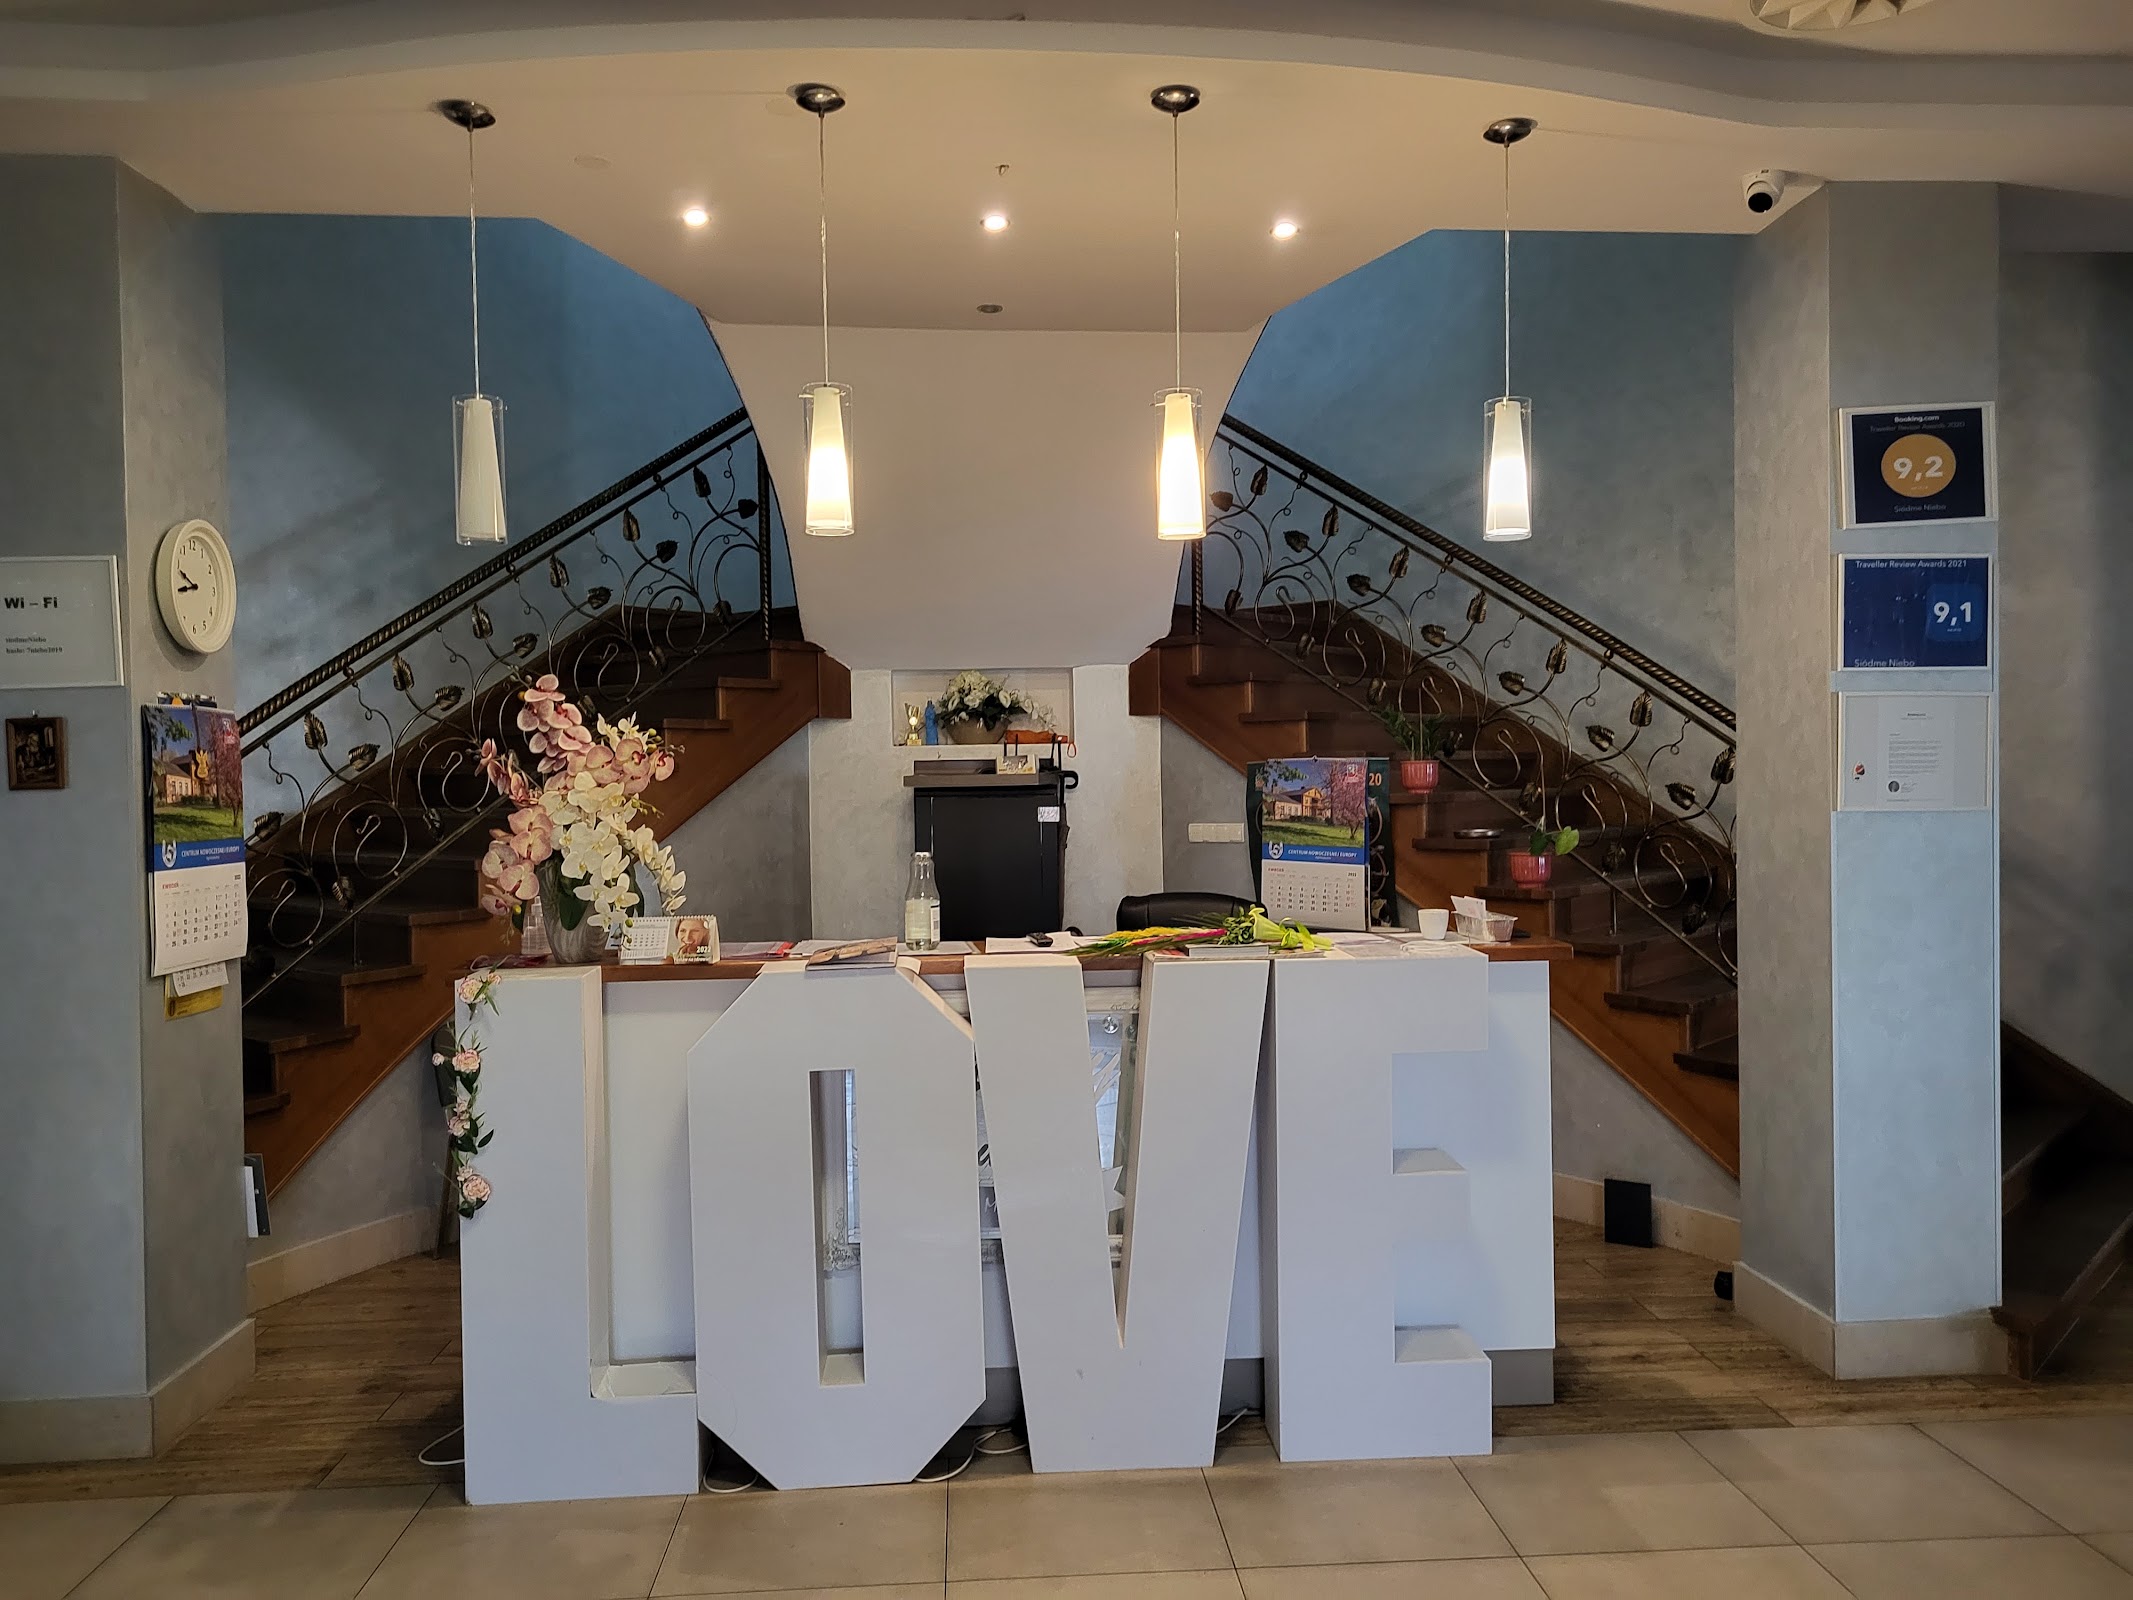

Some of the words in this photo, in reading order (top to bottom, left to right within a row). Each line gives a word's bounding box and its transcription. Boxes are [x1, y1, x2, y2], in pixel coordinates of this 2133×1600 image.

[1893, 456, 1944, 482] 9,2
[189, 540, 196, 551] 12
[208, 564, 212, 574] 2
[1856, 560, 1888, 568] Traveller
[1948, 560, 1967, 568] 2021
[212, 586, 215, 597] 3
[4, 596, 24, 609] Wi
[43, 596, 58, 608] Fi
[209, 606, 212, 616] 4
[1933, 602, 1972, 626] 9,1
[192, 624, 196, 634] 6
[202, 620, 206, 630] 5
[1854, 658, 1886, 667] Siódme
[1888, 658, 1916, 667] Niebo
[1369, 772, 1382, 786] 20
[455, 952, 1493, 1505] LOVE
